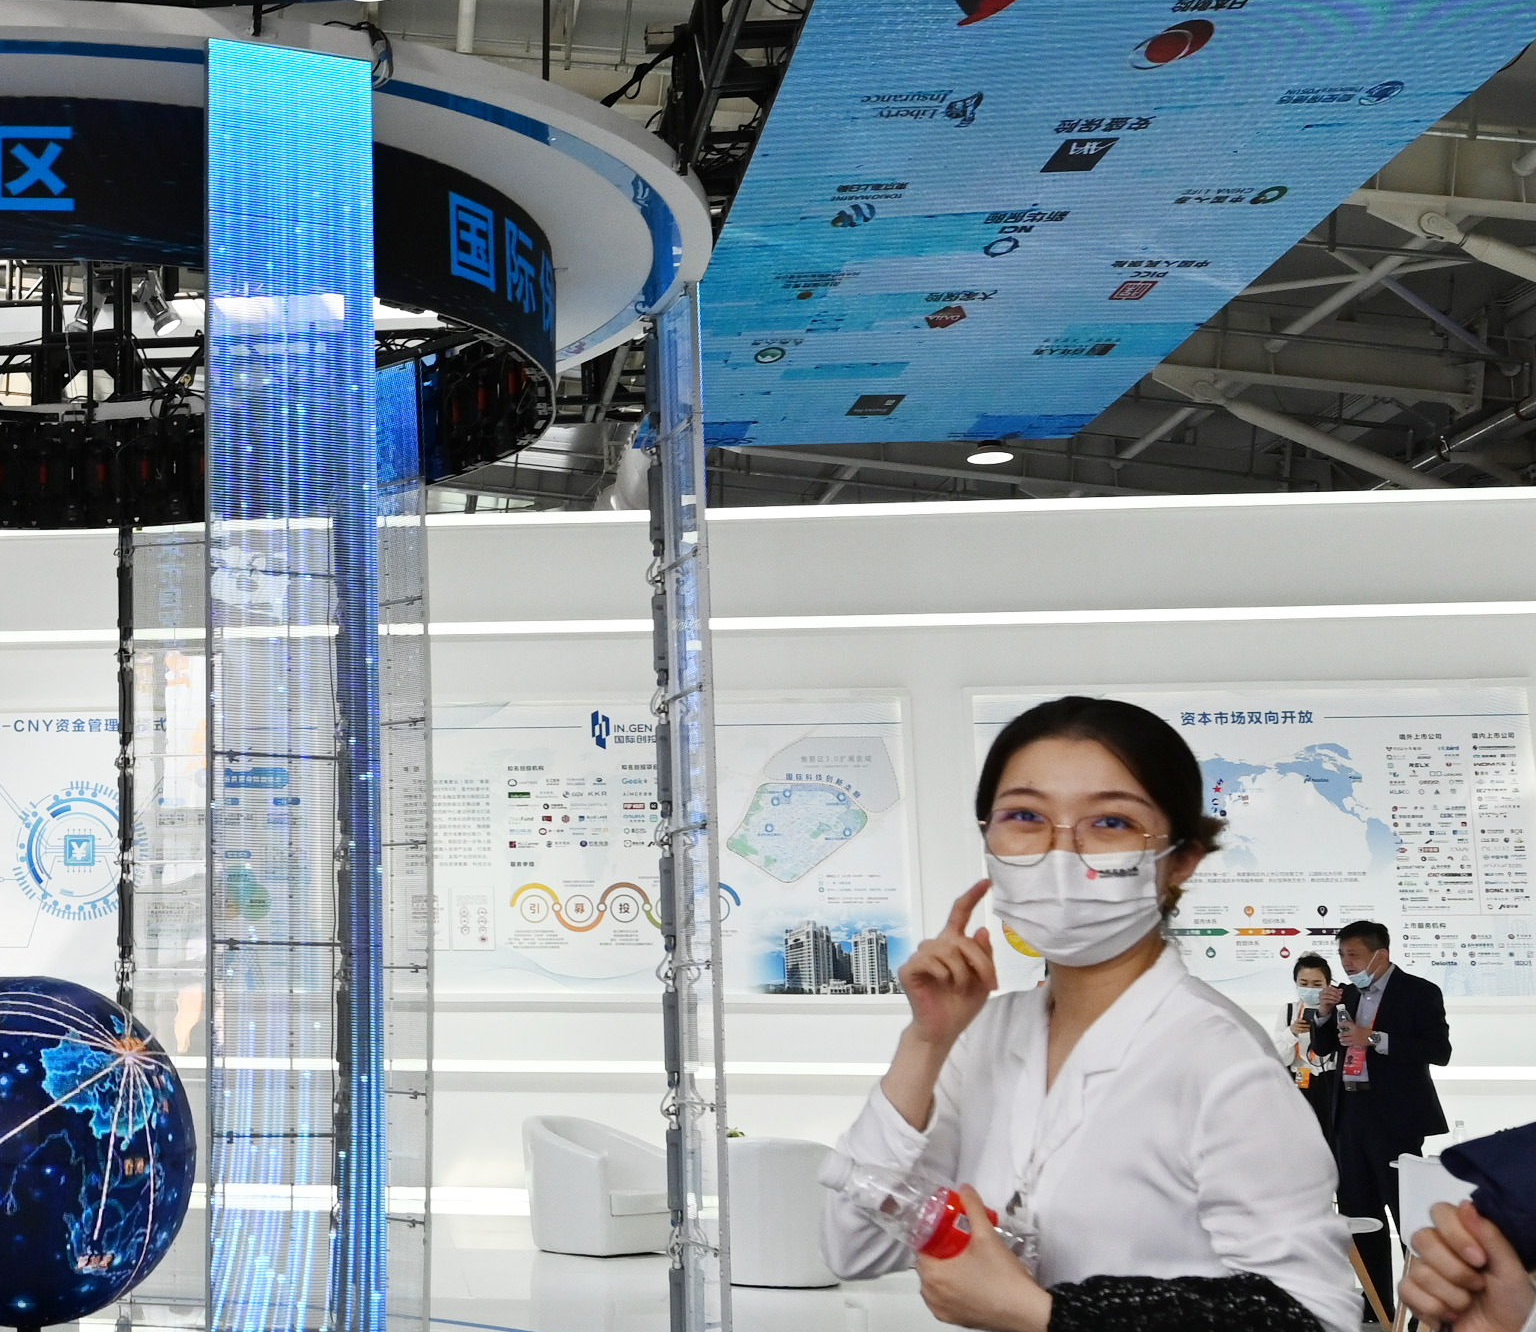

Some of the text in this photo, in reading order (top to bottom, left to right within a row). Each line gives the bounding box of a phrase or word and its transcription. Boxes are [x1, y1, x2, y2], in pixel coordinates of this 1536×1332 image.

[861, 93, 946, 105] Insurance
[875, 106, 939, 119] Liberty
[1053, 116, 1156, 134] 安盛保险
[1069, 140, 1117, 156] AXA
[999, 225, 1034, 234] NCI
[1180, 709, 1314, 726] 资本市场双向开放
[614, 724, 652, 733] IN.GEN
[622, 777, 648, 785] Geek+
[529, 903, 540, 914] 引
[619, 903, 630, 914] 投
